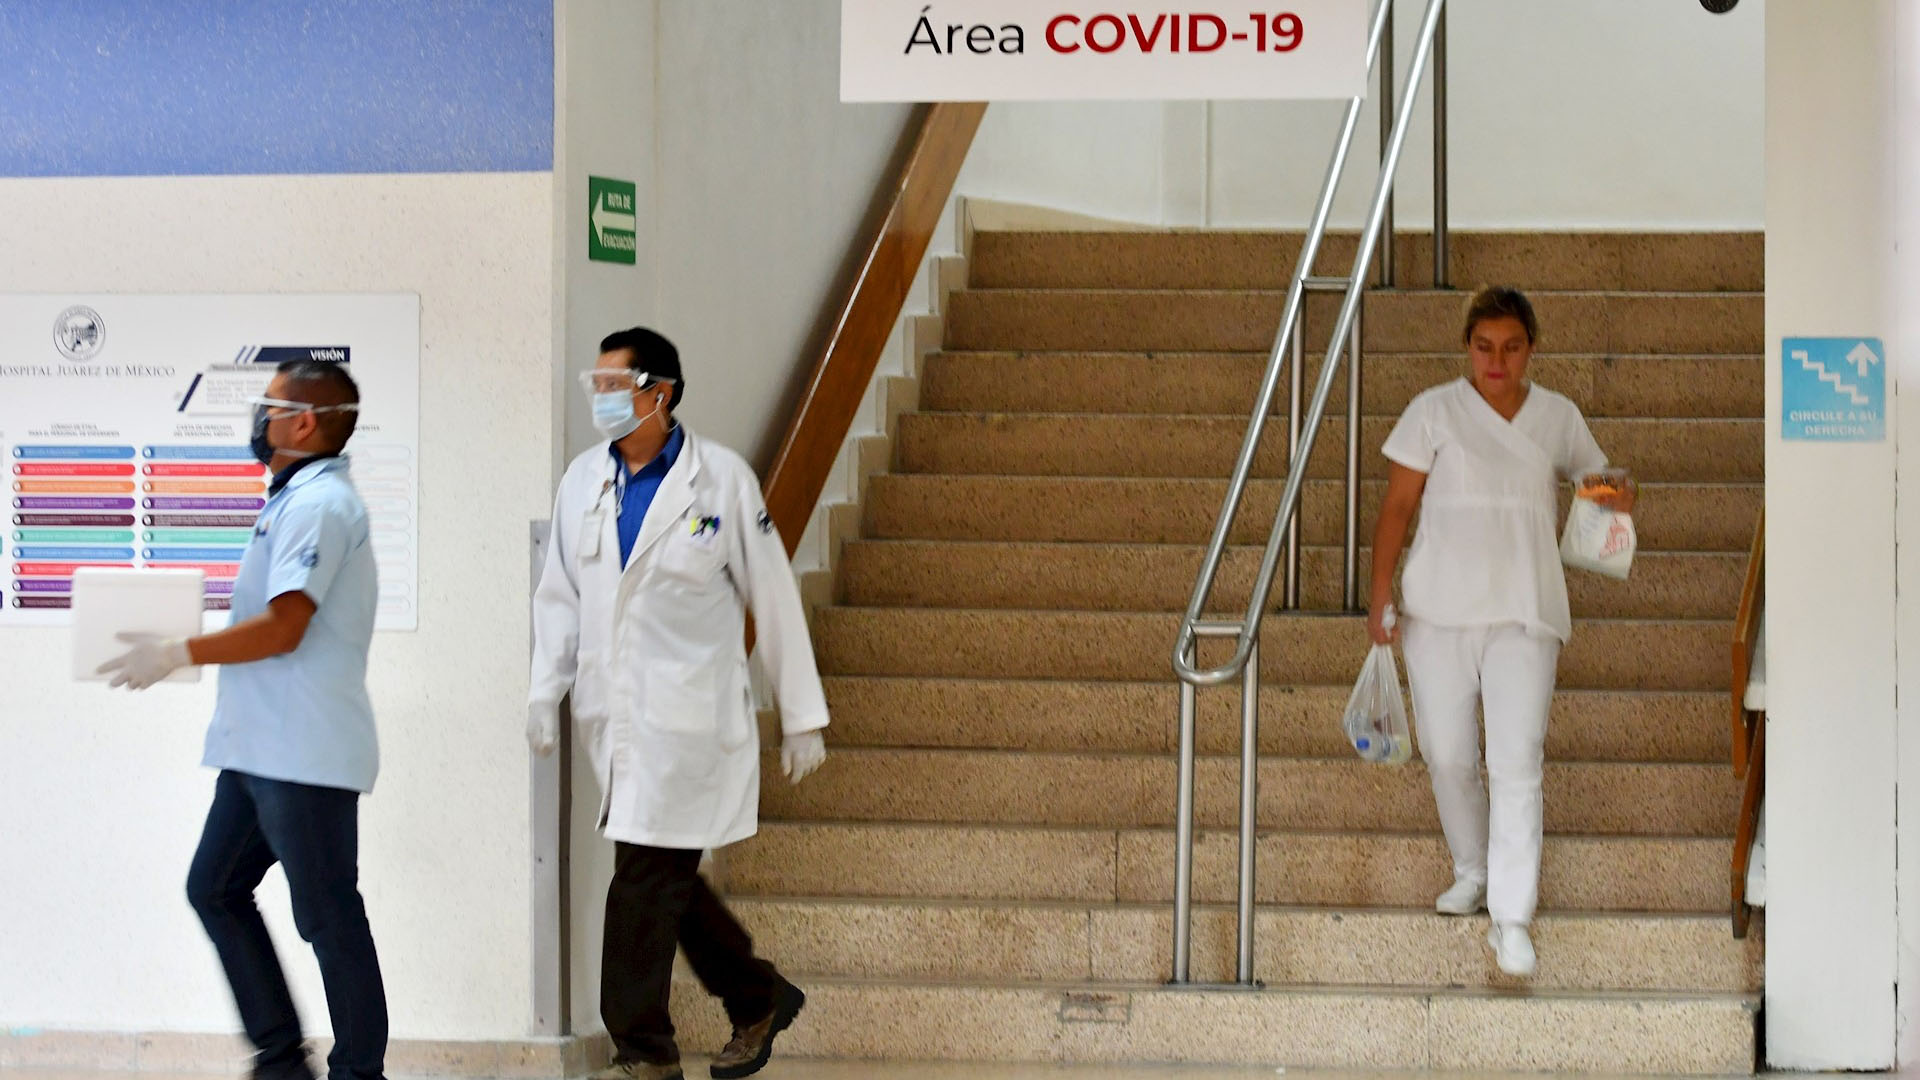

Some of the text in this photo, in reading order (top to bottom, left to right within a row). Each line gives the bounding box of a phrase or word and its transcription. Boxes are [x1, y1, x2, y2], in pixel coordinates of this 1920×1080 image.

[904, 5, 1304, 55] Área COVID-19
[607, 192, 632, 210] RUTA DE
[309, 347, 345, 361] VISIÓN
[0, 364, 52, 377] OSPITAL
[1790, 410, 1877, 421] CIRCULE A SU
[1804, 425, 1866, 436] DERECHA
